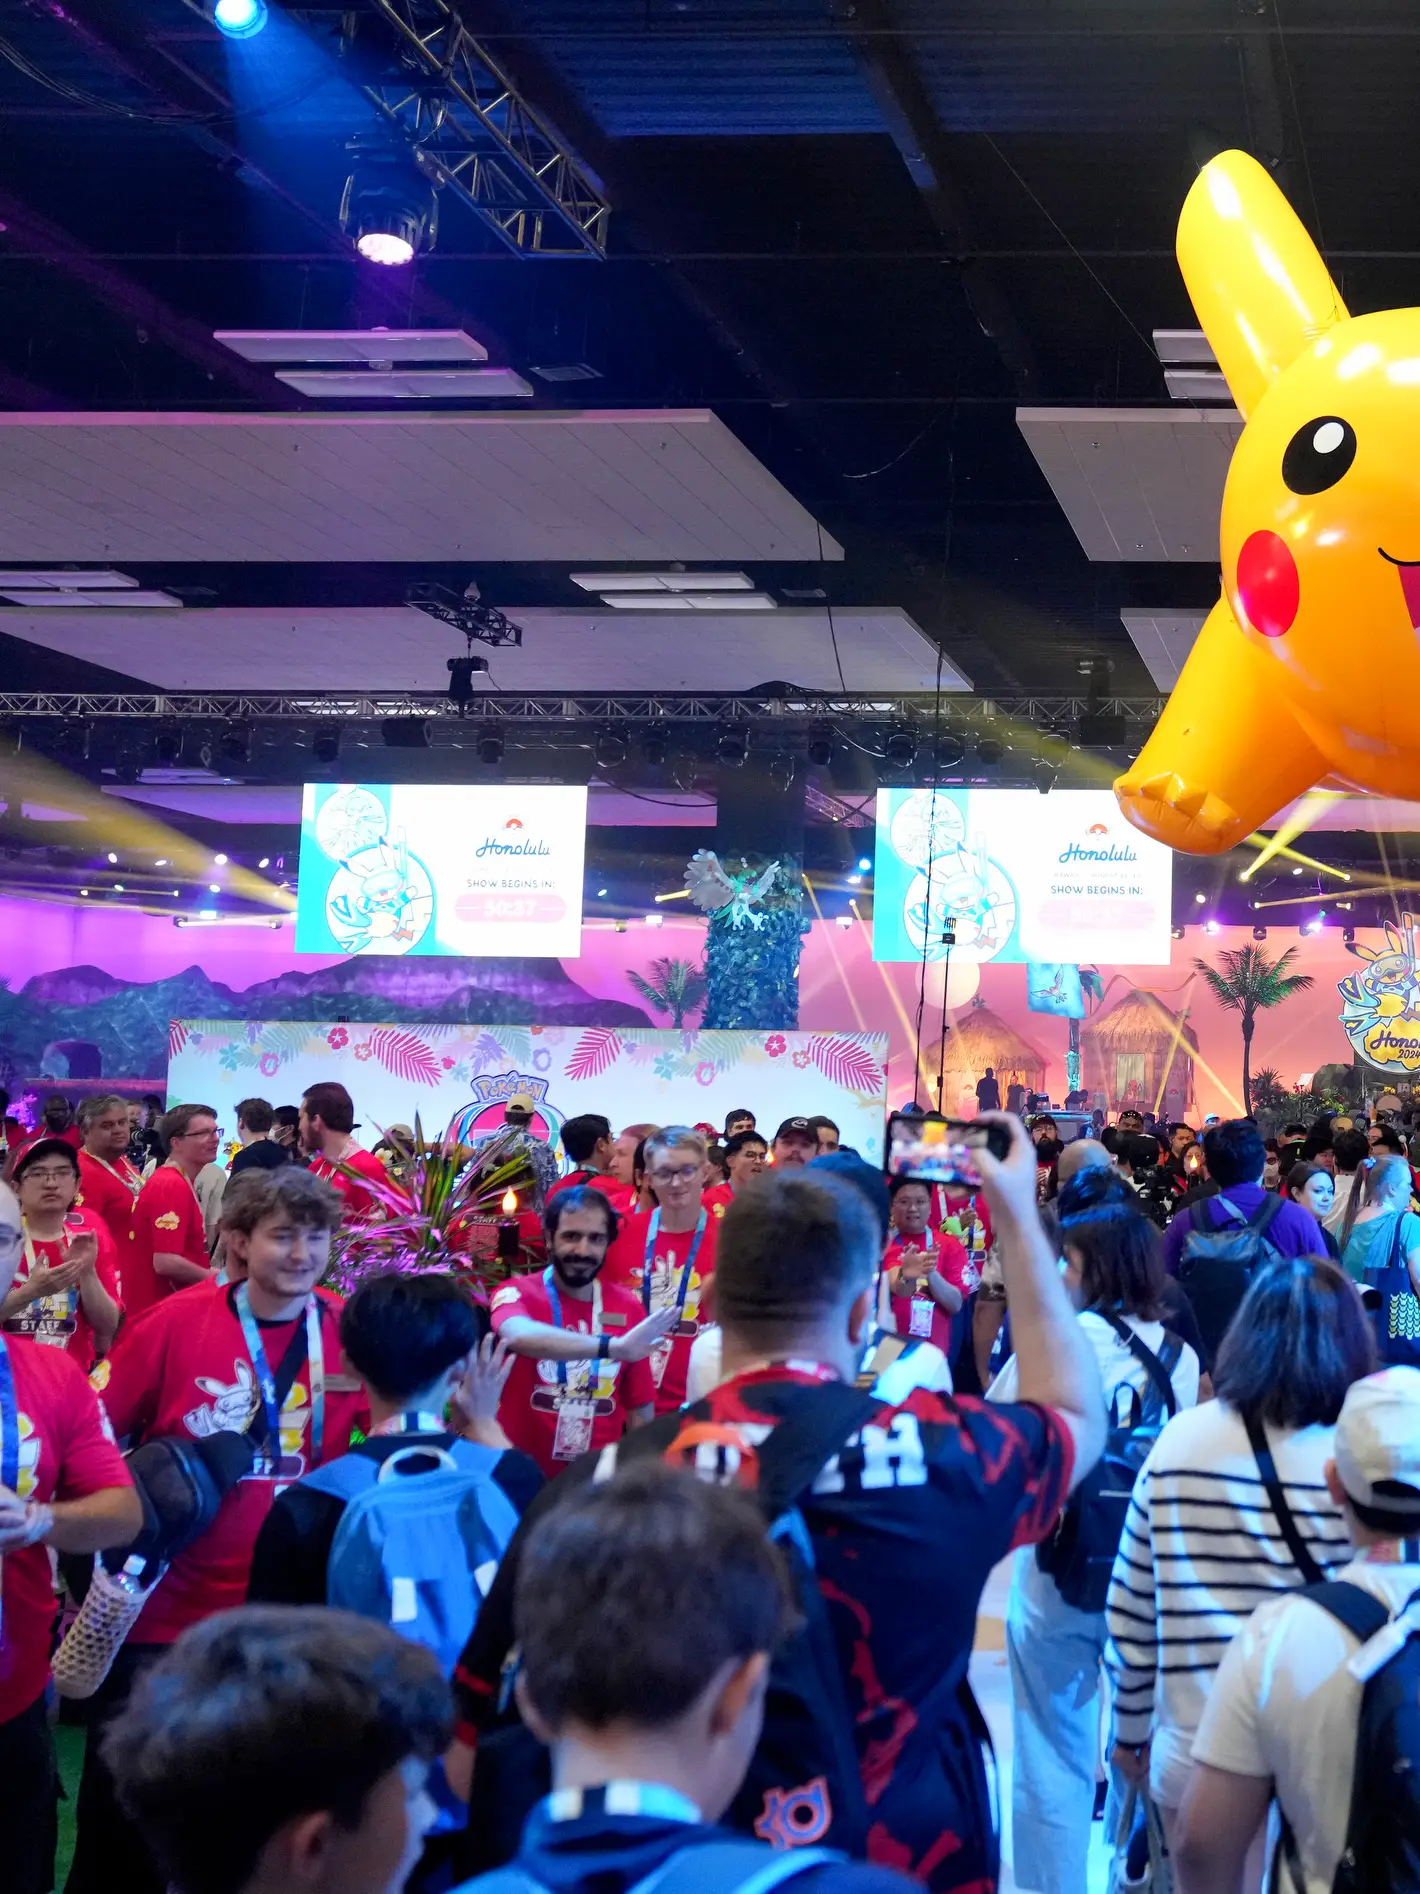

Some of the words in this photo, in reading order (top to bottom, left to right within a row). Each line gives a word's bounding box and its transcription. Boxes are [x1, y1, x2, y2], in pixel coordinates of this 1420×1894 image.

[476, 837, 550, 858] Honolulu
[1058, 842, 1137, 863] Honolulu
[467, 879, 498, 888] SHOW
[501, 879, 538, 889] BEGINS
[541, 880, 556, 889] IN:
[1050, 885, 1083, 894] SHOW
[1087, 885, 1126, 895] BEGINS
[1128, 886, 1143, 895] IN:
[1397, 1049, 1420, 1059] 2024
[20, 1320, 60, 1332] STAFF
